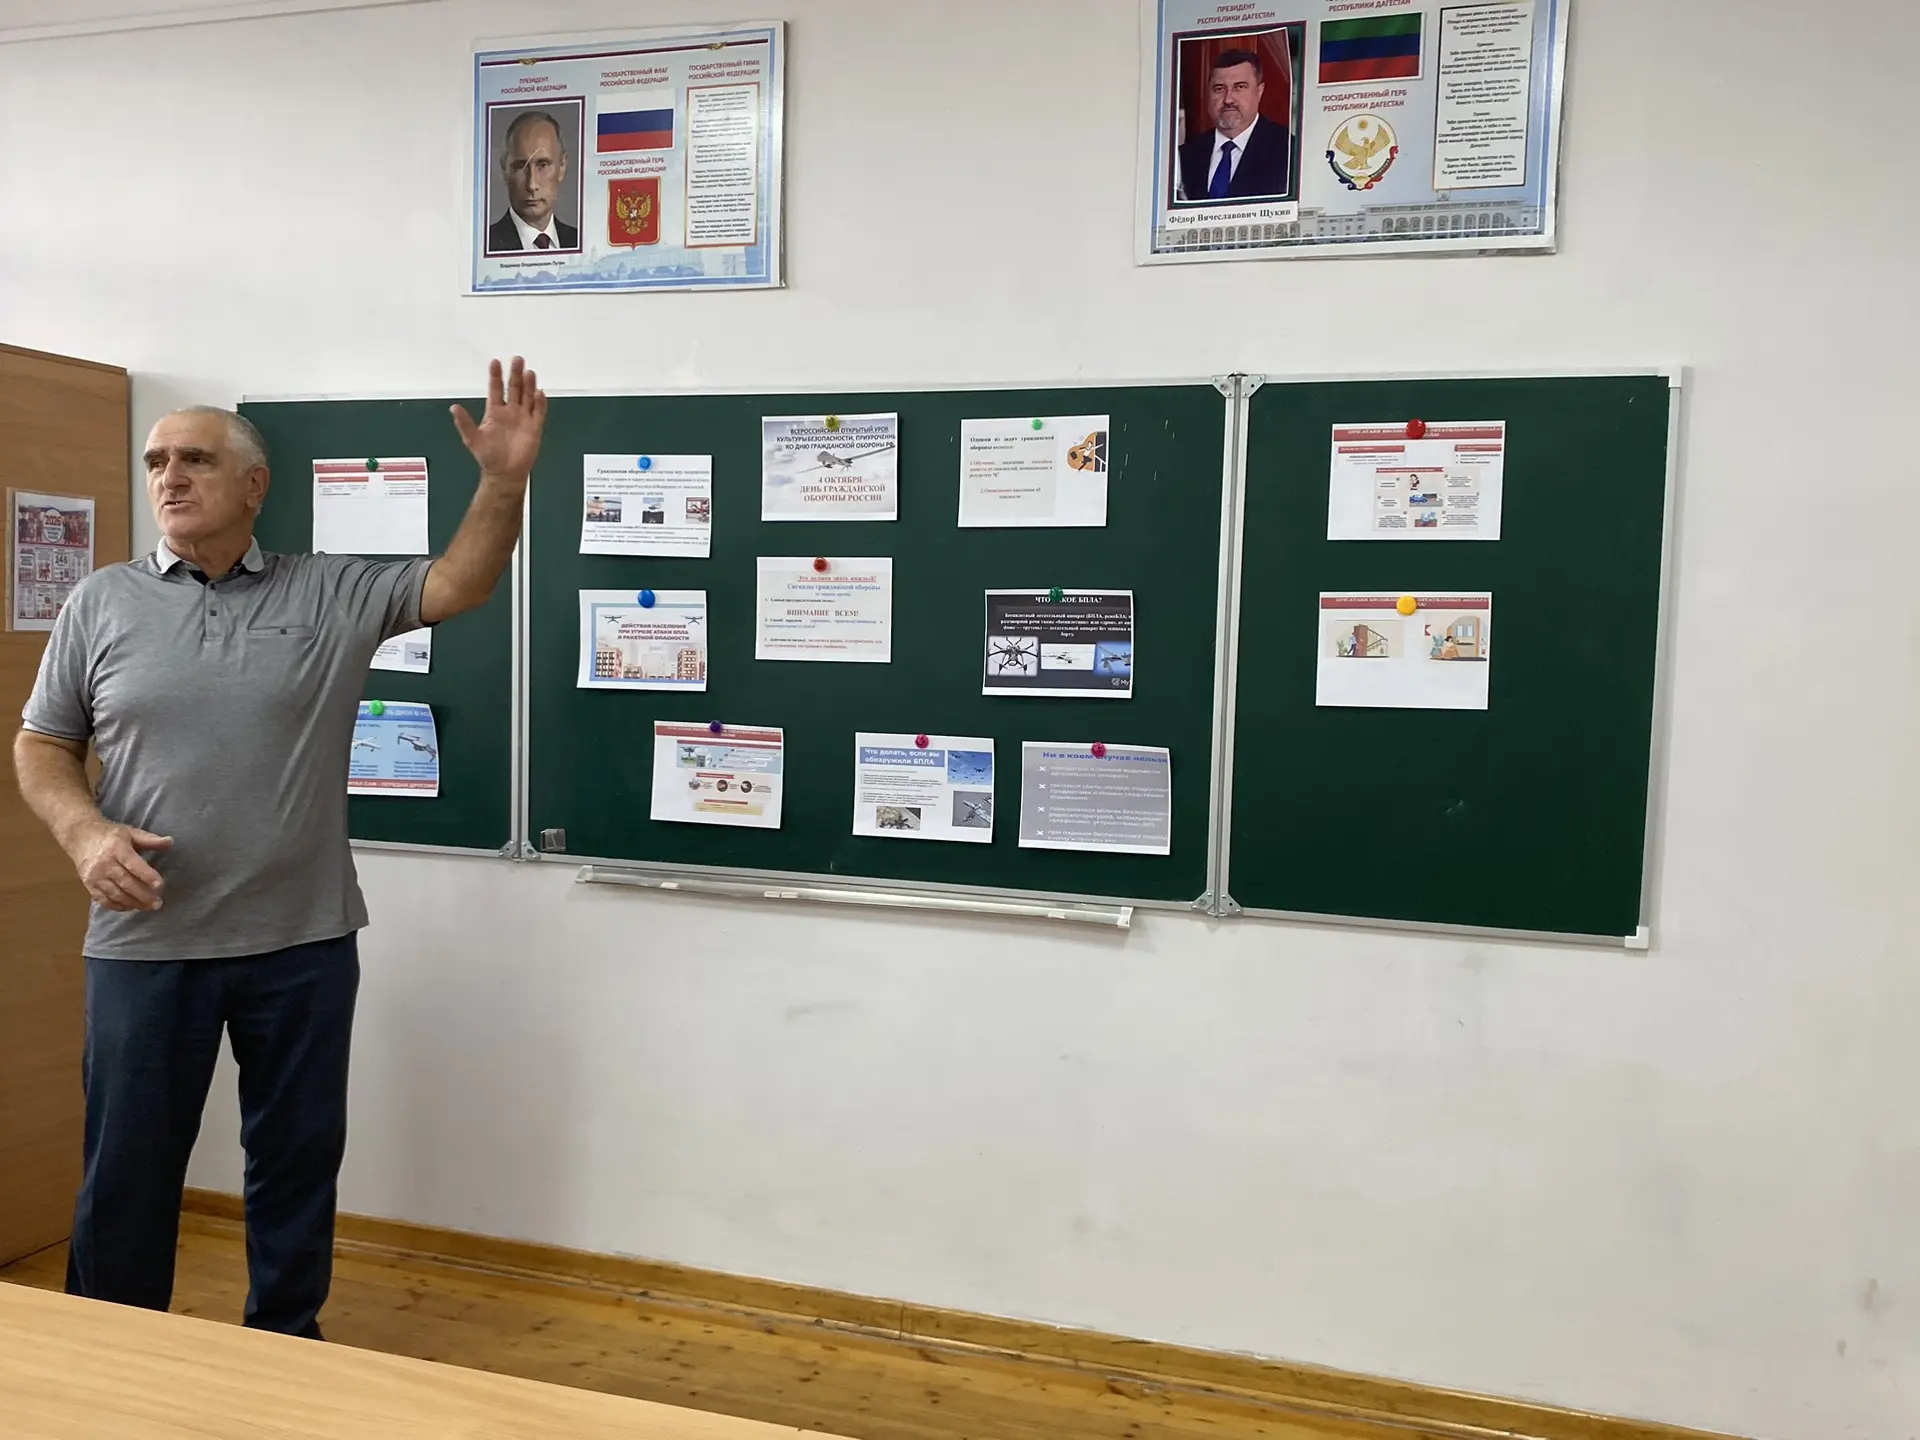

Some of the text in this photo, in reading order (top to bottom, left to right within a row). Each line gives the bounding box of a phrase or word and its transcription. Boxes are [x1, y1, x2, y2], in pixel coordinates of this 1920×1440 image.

[1216, 2, 1256, 12] ПРЕЗИДЕНТ
[1196, 11, 1276, 24] РЕСПУБЛИКИ ДАГЕСТАН
[1321, 89, 1408, 102] ГОСУДАРСТВЕННЫЙ ГЕРБ
[1323, 100, 1405, 112] РЕСПУБЛИКИ ДАГЕСТАН
[1169, 208, 1291, 225] Фёдор Вячеславович Щукин
[841, 425, 874, 434] ОТКРЫТЫЙ
[810, 441, 855, 450] ГРАЖДАНСКОЙ
[824, 476, 863, 484] ОКТЯБРЯ
[800, 483, 886, 494] ДЕНЬ ГРАЖДАНСКОЙ
[803, 494, 882, 502] ОБОРОНЫ РОССИИ
[834, 609, 859, 617] ВСЕМ!
[864, 757, 912, 765] обнаружили
